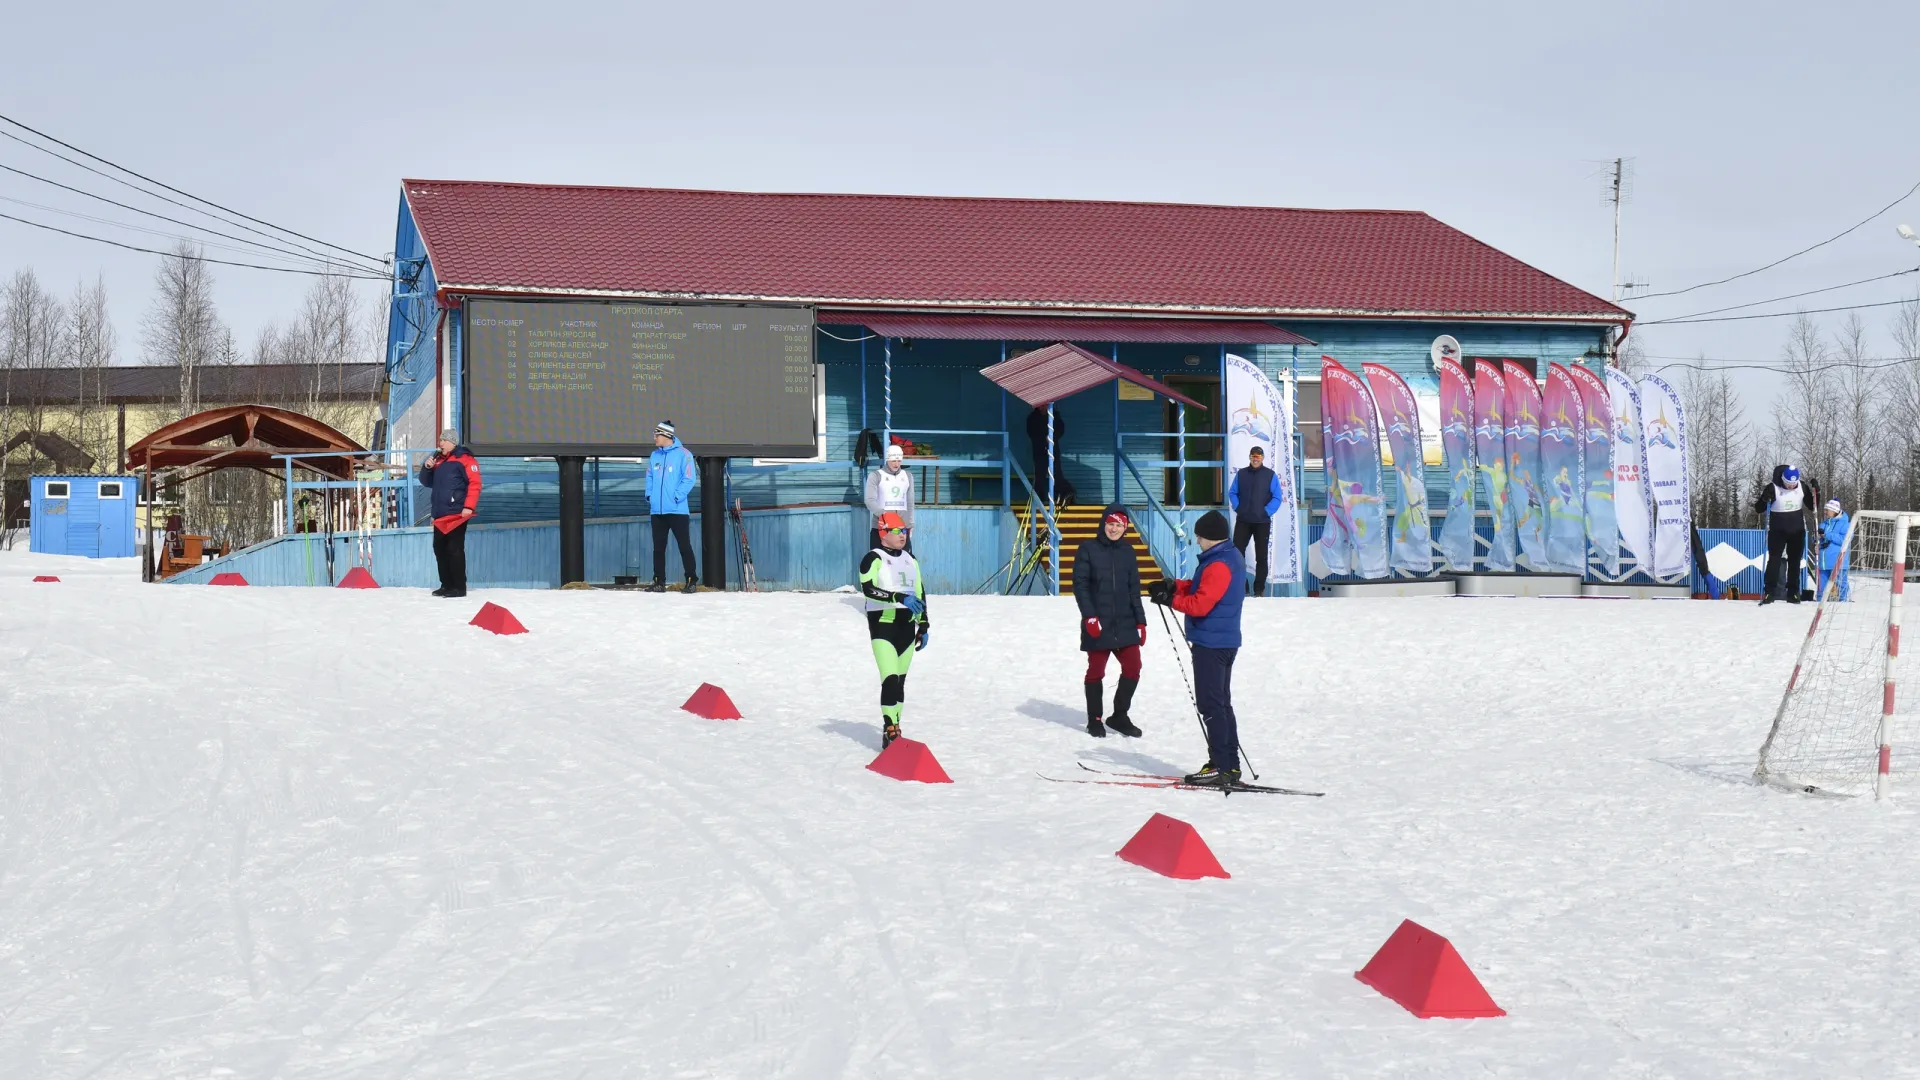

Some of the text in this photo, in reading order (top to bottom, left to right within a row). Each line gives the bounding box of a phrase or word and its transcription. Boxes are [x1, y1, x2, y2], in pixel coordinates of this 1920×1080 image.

[611, 306, 683, 315] ПРОТОКОЛ СТАРТА
[498, 319, 524, 327] НОМЕР
[560, 320, 598, 328] УЧАСТНИК
[631, 321, 664, 329] КОМАНДА
[769, 324, 807, 332] РЕЗУЛЬТАТ
[507, 340, 517, 348] 02
[632, 342, 668, 350] ФИНАНСЫ
[559, 350, 592, 359] АЛЕКСЕЙ
[577, 361, 606, 370] СЕРГЕЙ
[632, 361, 664, 370] АЙСБЕРГ
[507, 382, 517, 390] 06
[568, 383, 594, 391] ДЕНИС
[891, 486, 901, 498] 9
[898, 571, 910, 587] 1
